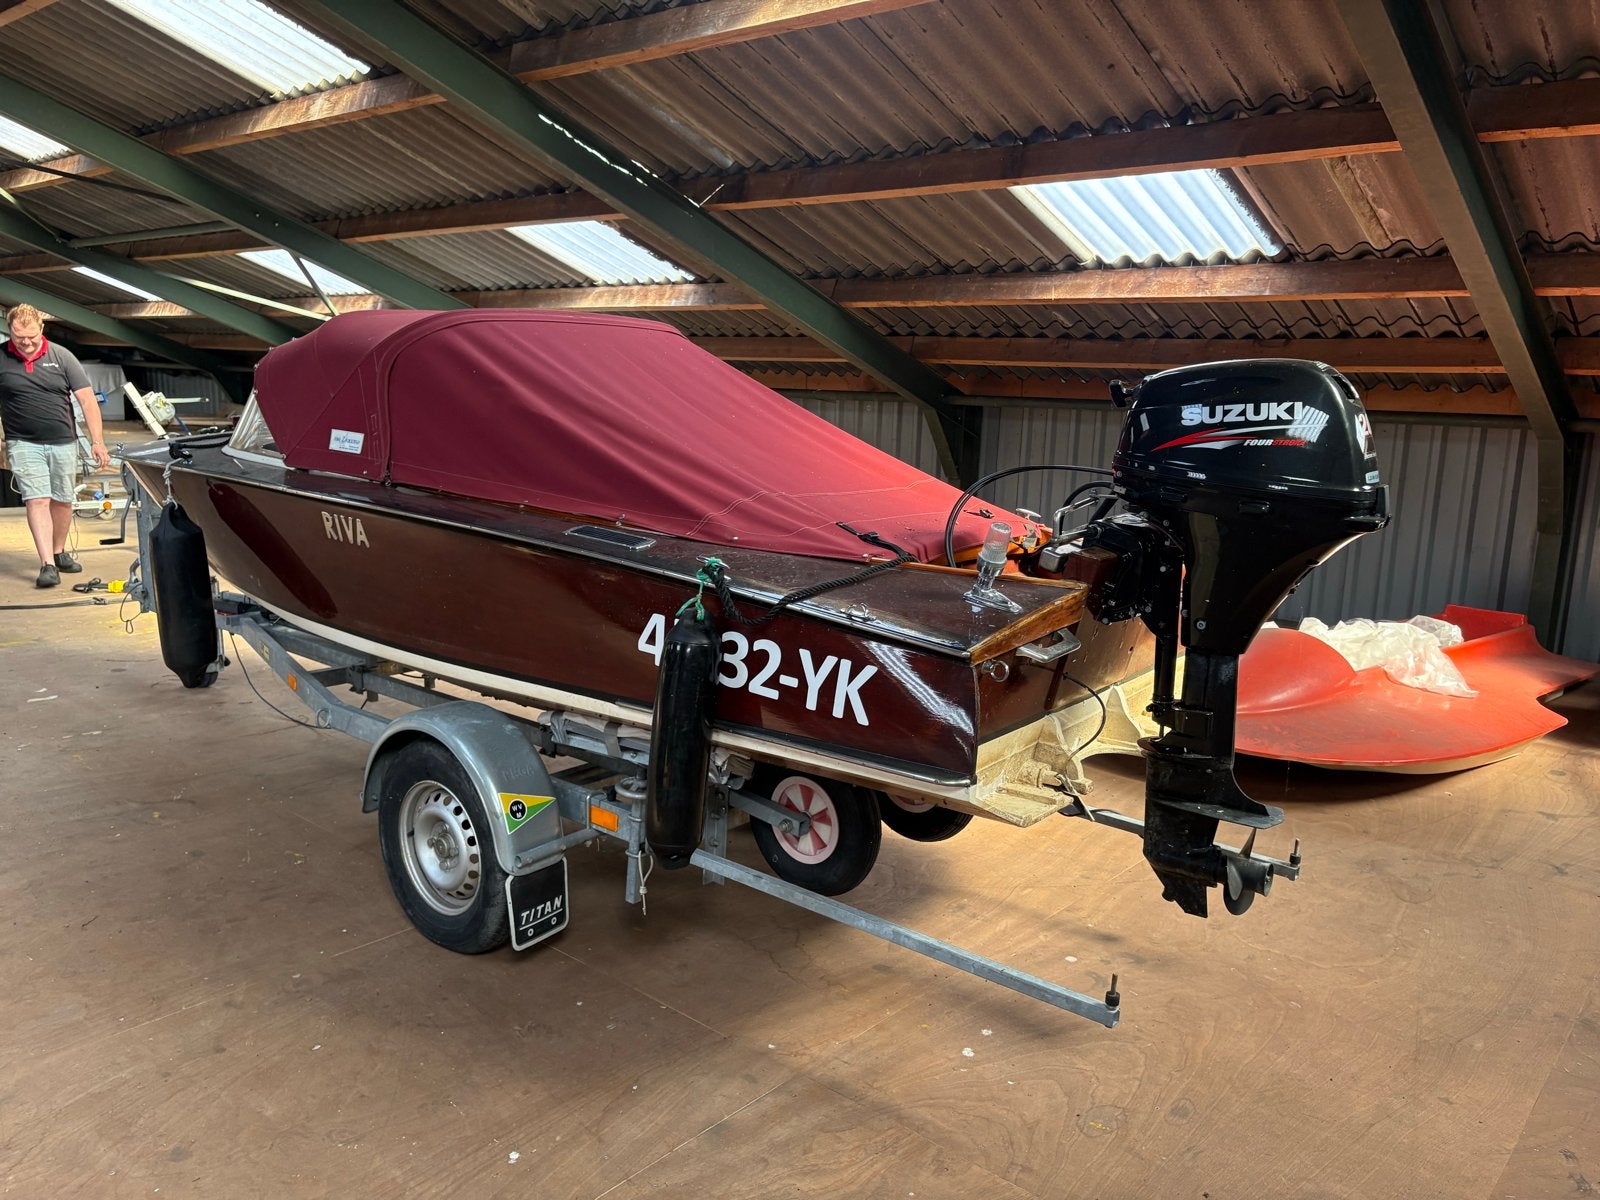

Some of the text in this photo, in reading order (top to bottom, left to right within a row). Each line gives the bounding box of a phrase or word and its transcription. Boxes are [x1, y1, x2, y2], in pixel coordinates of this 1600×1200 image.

[1181, 401, 1303, 426] SUZUKI
[321, 511, 370, 548] RIVA
[520, 895, 562, 926] TITAN
